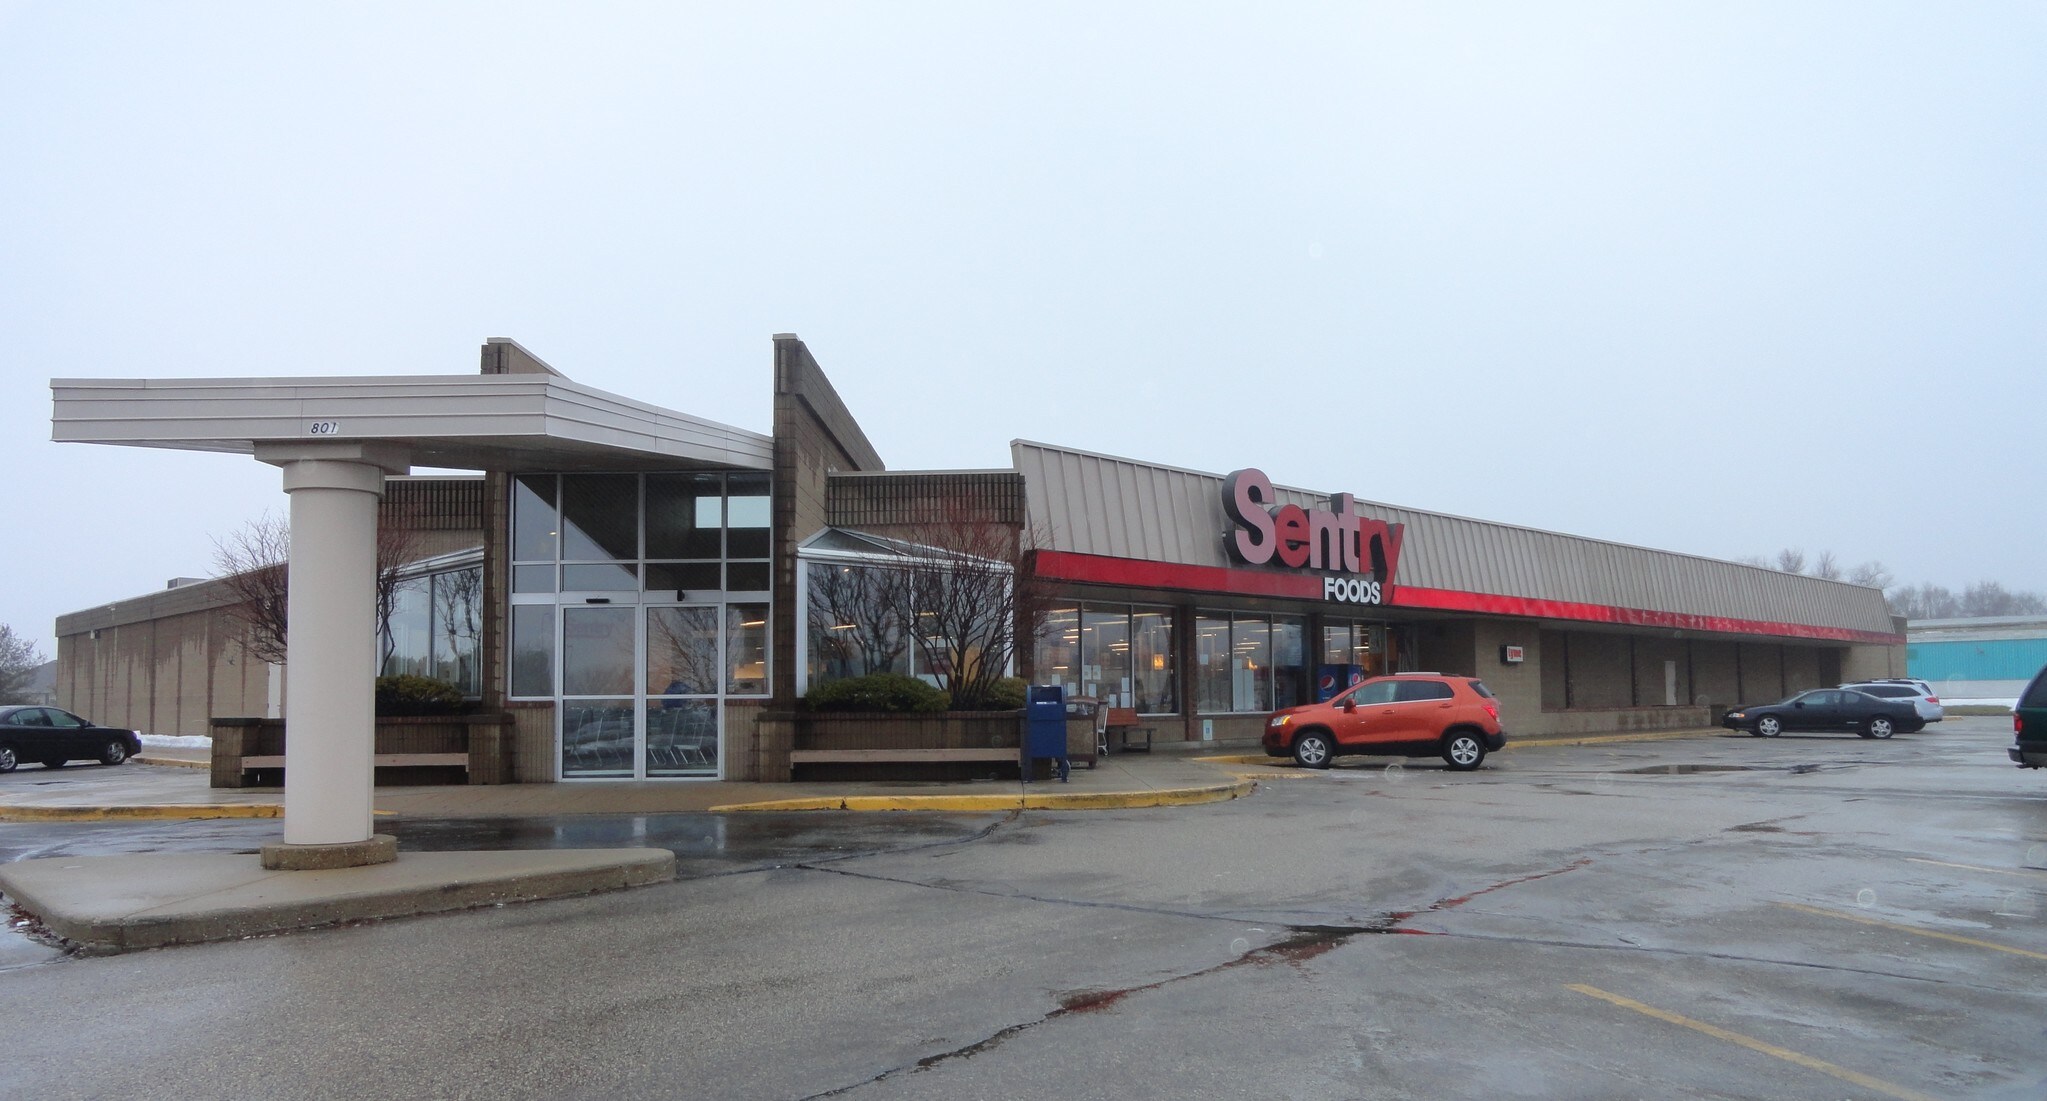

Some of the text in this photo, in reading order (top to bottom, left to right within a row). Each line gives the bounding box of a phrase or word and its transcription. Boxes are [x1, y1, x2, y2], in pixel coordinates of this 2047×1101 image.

[311, 422, 337, 434] 801
[1226, 467, 1405, 605] Sentry
[1324, 577, 1381, 605] FOODS
